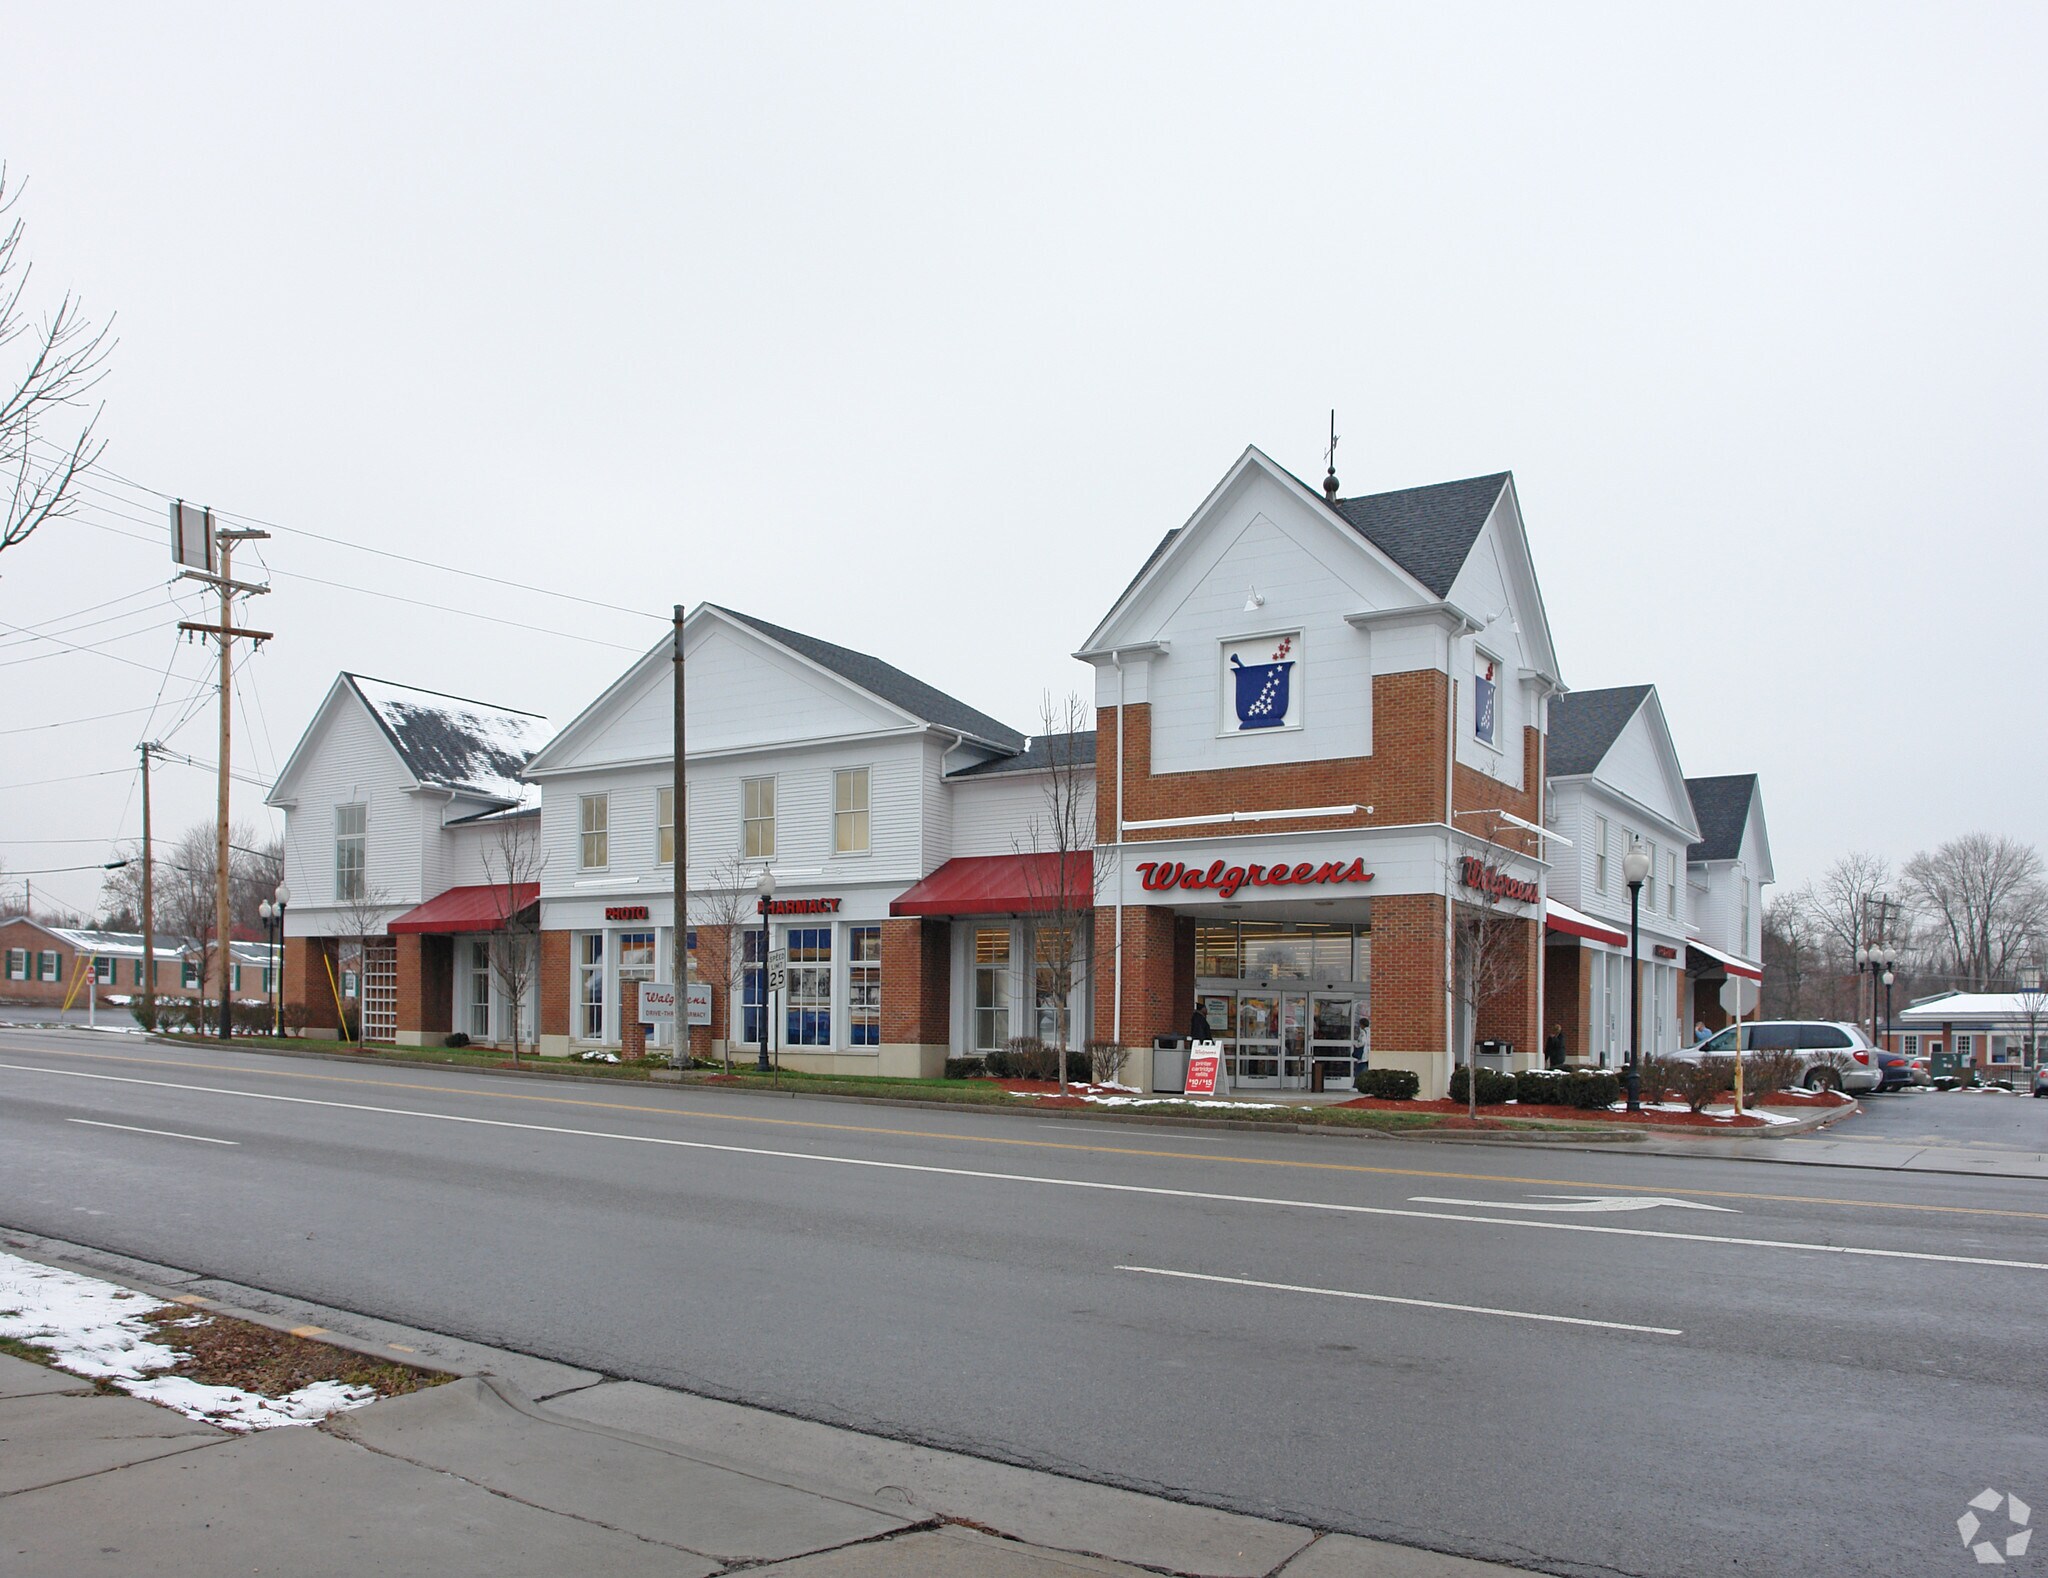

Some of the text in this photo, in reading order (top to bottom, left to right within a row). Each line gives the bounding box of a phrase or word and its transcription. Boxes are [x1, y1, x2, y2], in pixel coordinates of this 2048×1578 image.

[1136, 857, 1375, 898] Walgreens
[605, 906, 649, 920] PHOTO
[769, 952, 785, 962] SPEED
[770, 961, 783, 970] LIMIT
[770, 970, 784, 987] 25
[645, 992, 707, 1006] Walgens
